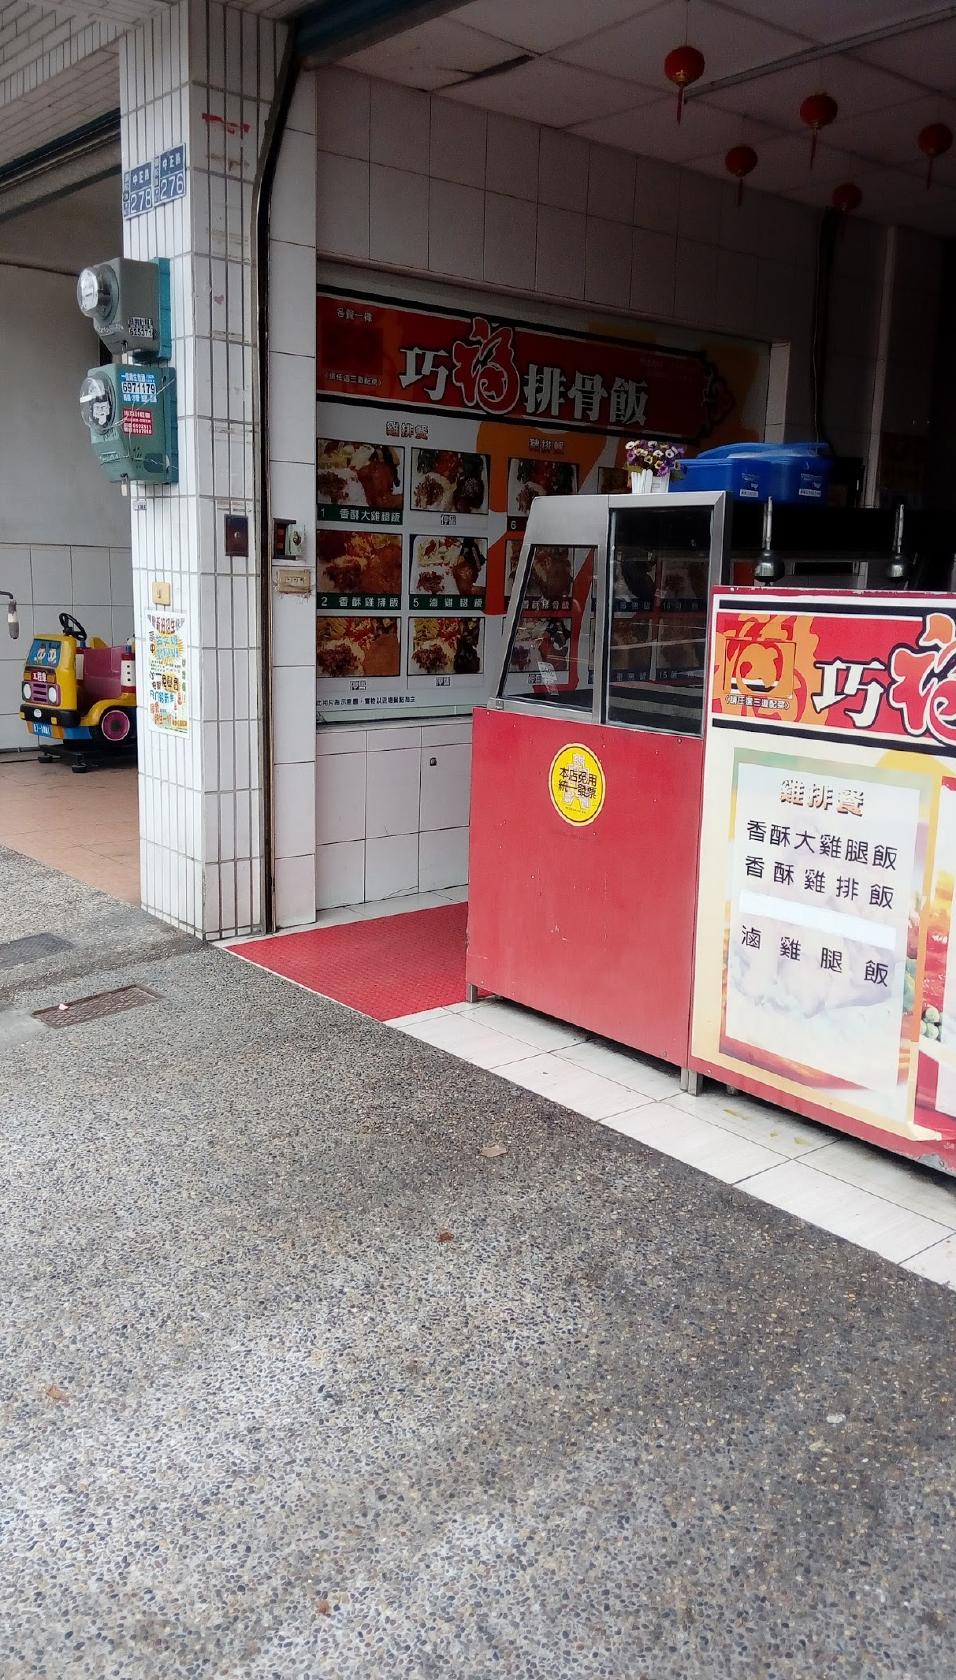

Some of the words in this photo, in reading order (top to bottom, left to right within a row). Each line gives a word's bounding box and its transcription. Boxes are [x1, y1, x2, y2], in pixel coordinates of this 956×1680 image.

[161, 173, 184, 200] 276
[131, 188, 152, 213] 278
[122, 382, 156, 394] 6971179
[510, 520, 517, 530] 6
[321, 596, 327, 607] 2
[413, 597, 420, 608] 5
[559, 767, 597, 787] 本店免用
[747, 819, 898, 871] 香酥大雞腿飯
[745, 856, 894, 910] 香酥雞排飯
[741, 925, 889, 987] 滷雞腿飯
